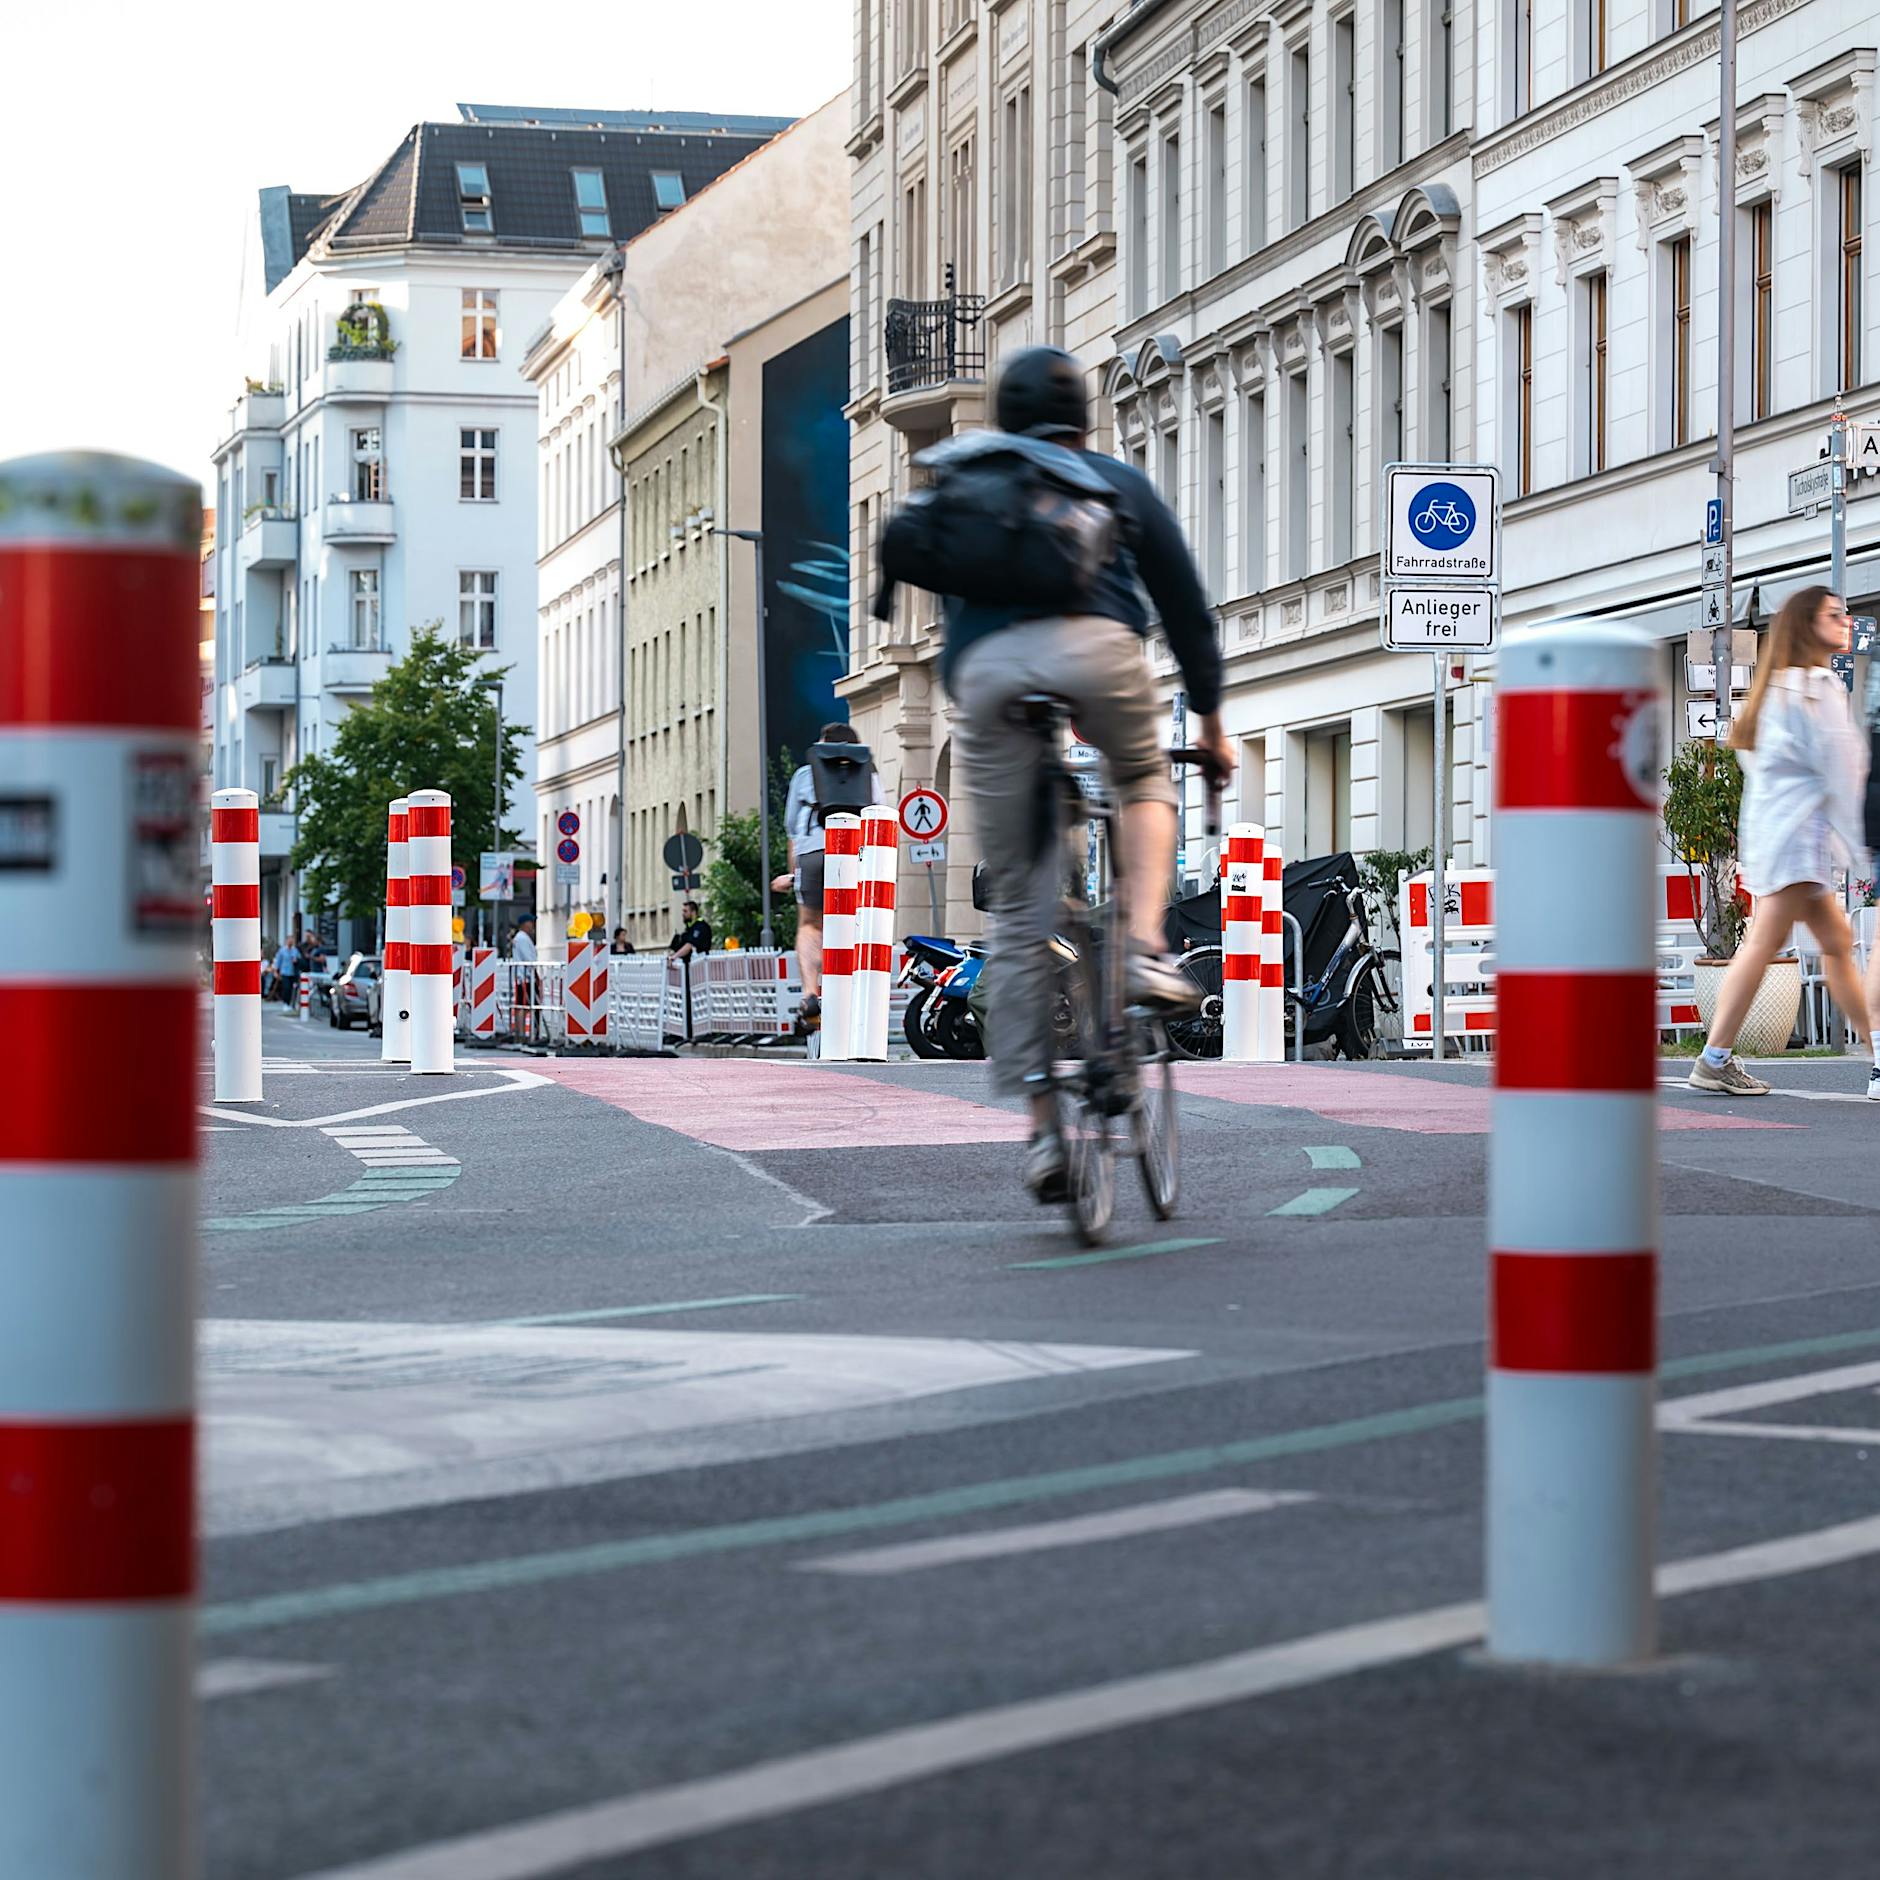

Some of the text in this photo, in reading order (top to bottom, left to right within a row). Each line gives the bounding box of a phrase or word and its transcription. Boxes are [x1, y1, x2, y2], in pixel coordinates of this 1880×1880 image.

[1396, 556, 1486, 569] Fahrradstraße
[1401, 598, 1481, 619] Anlieger
[1426, 620, 1457, 637] frei
